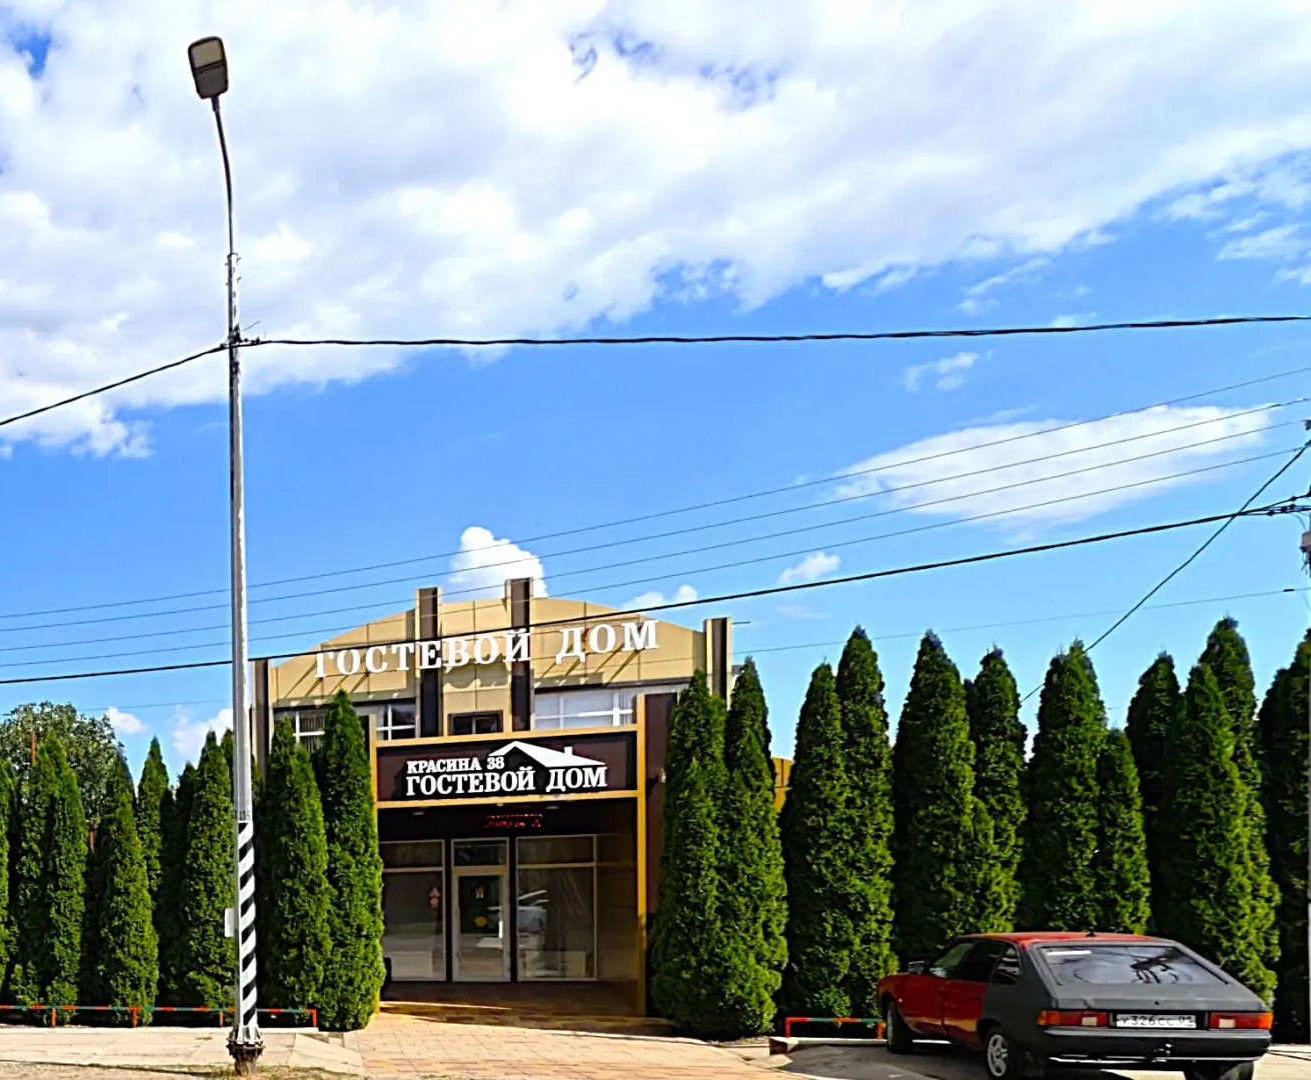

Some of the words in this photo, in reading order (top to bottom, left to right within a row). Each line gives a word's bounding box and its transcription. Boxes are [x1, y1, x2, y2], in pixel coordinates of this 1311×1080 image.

[314, 627, 531, 678] ГОСТЕВОЙ
[555, 619, 660, 664] ДОМ
[406, 757, 482, 774] КРАСИНА
[487, 756, 505, 770] 38
[406, 766, 536, 796] ГОСТЕВОЙ
[545, 766, 608, 793] ДОМ
